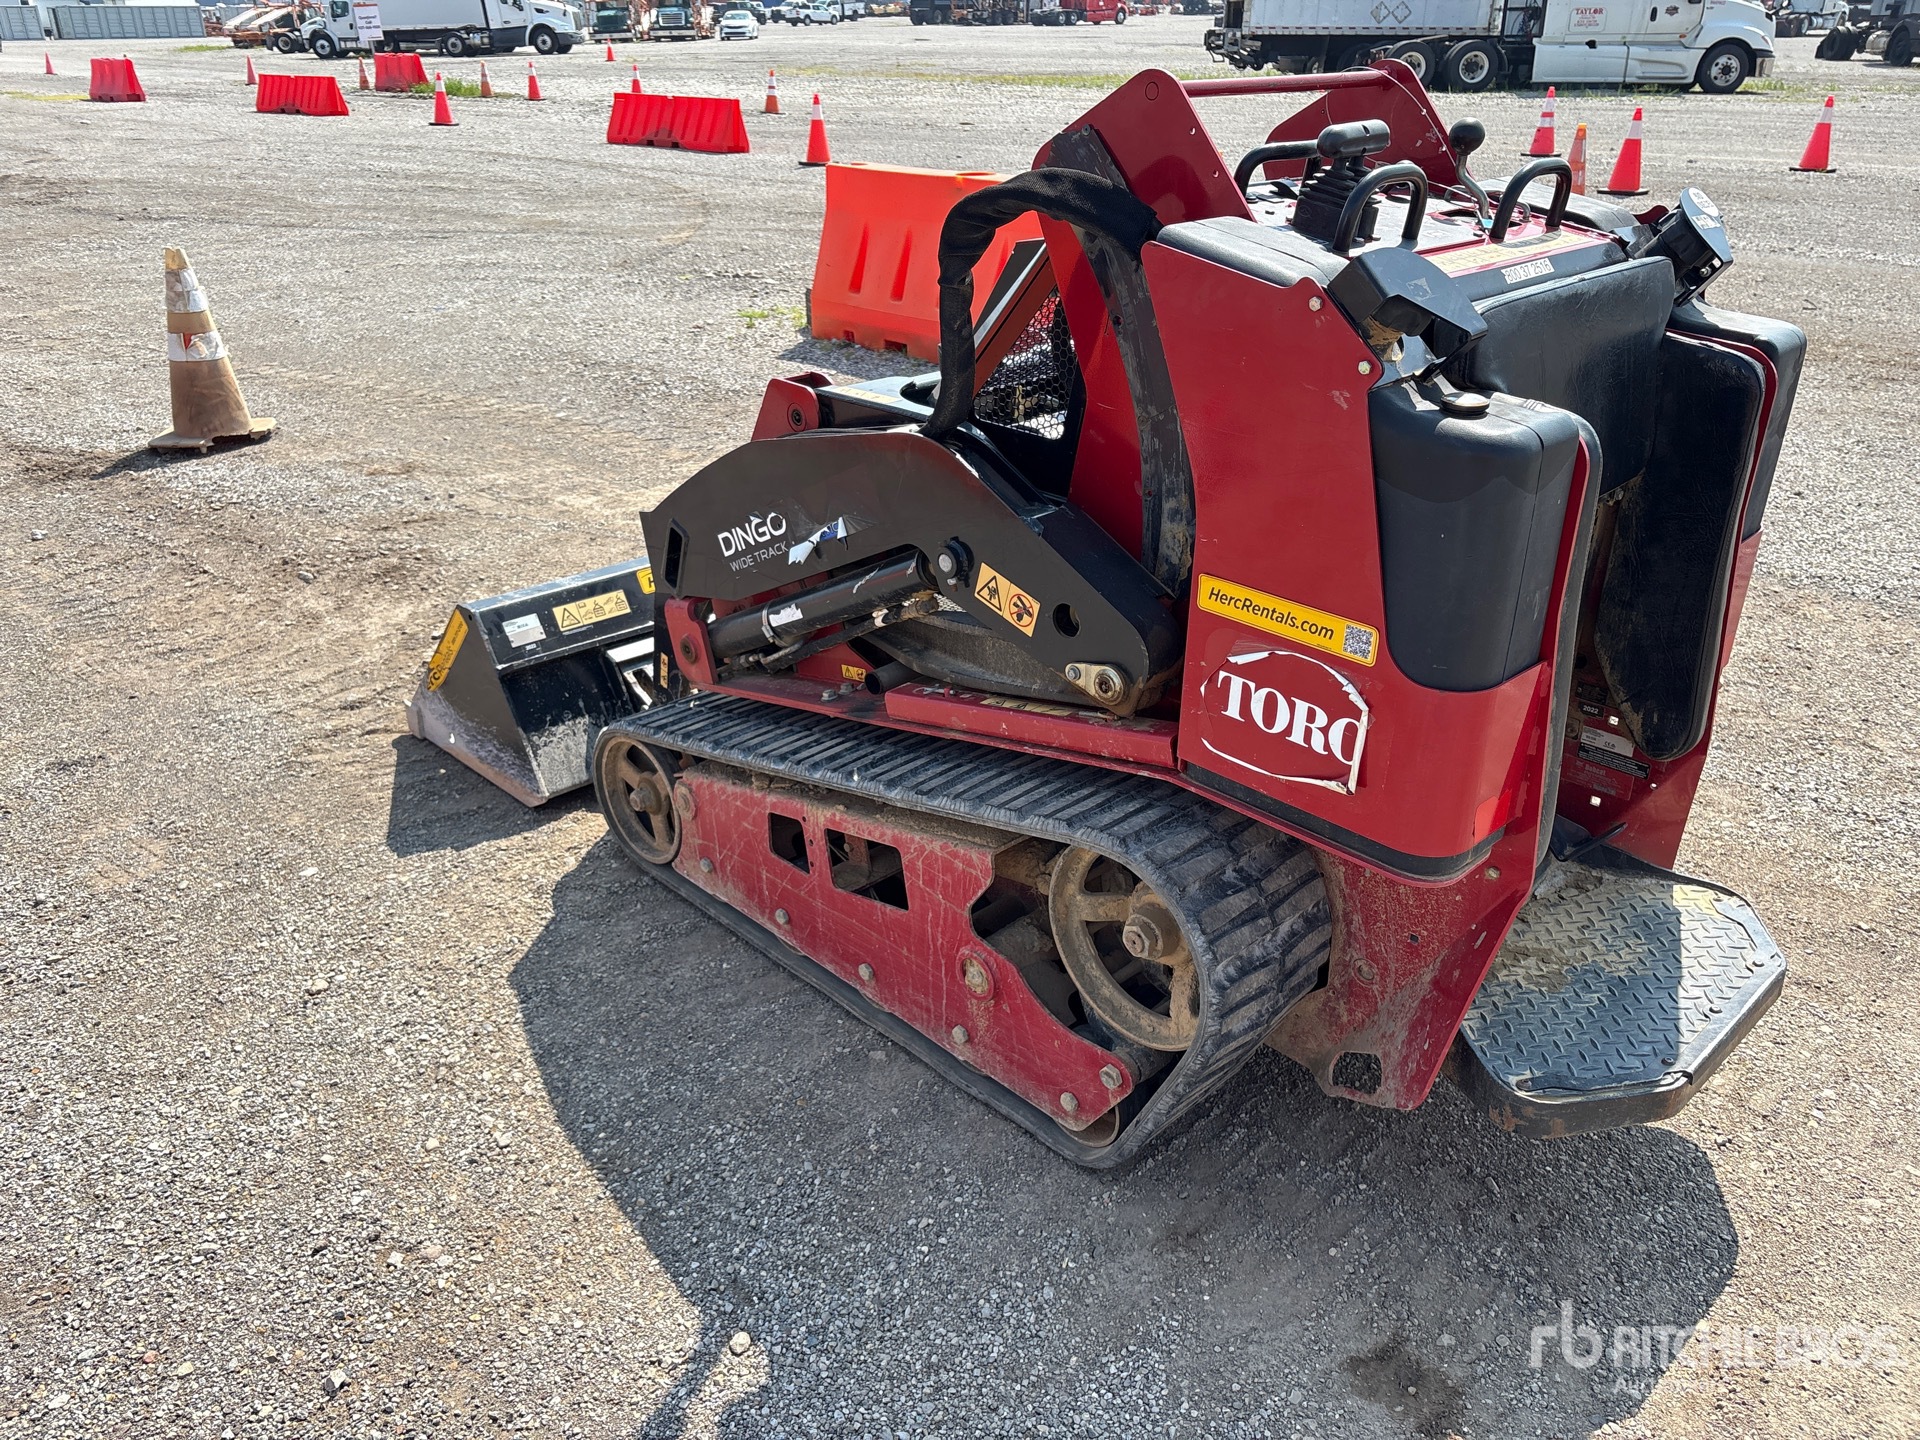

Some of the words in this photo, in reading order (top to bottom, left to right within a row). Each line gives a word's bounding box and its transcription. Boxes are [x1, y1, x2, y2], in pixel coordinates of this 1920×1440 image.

[1575, 7, 1604, 15] TAYLOR
[1505, 267, 1521, 282] 800
[1520, 264, 1532, 279] 37
[1533, 260, 1552, 276] 2516
[717, 512, 787, 557] DINGO
[729, 556, 756, 572] WIDE
[755, 541, 789, 563] TRACK
[1208, 586, 1335, 641] HercRentals.com
[1583, 705, 1599, 714] 2022
